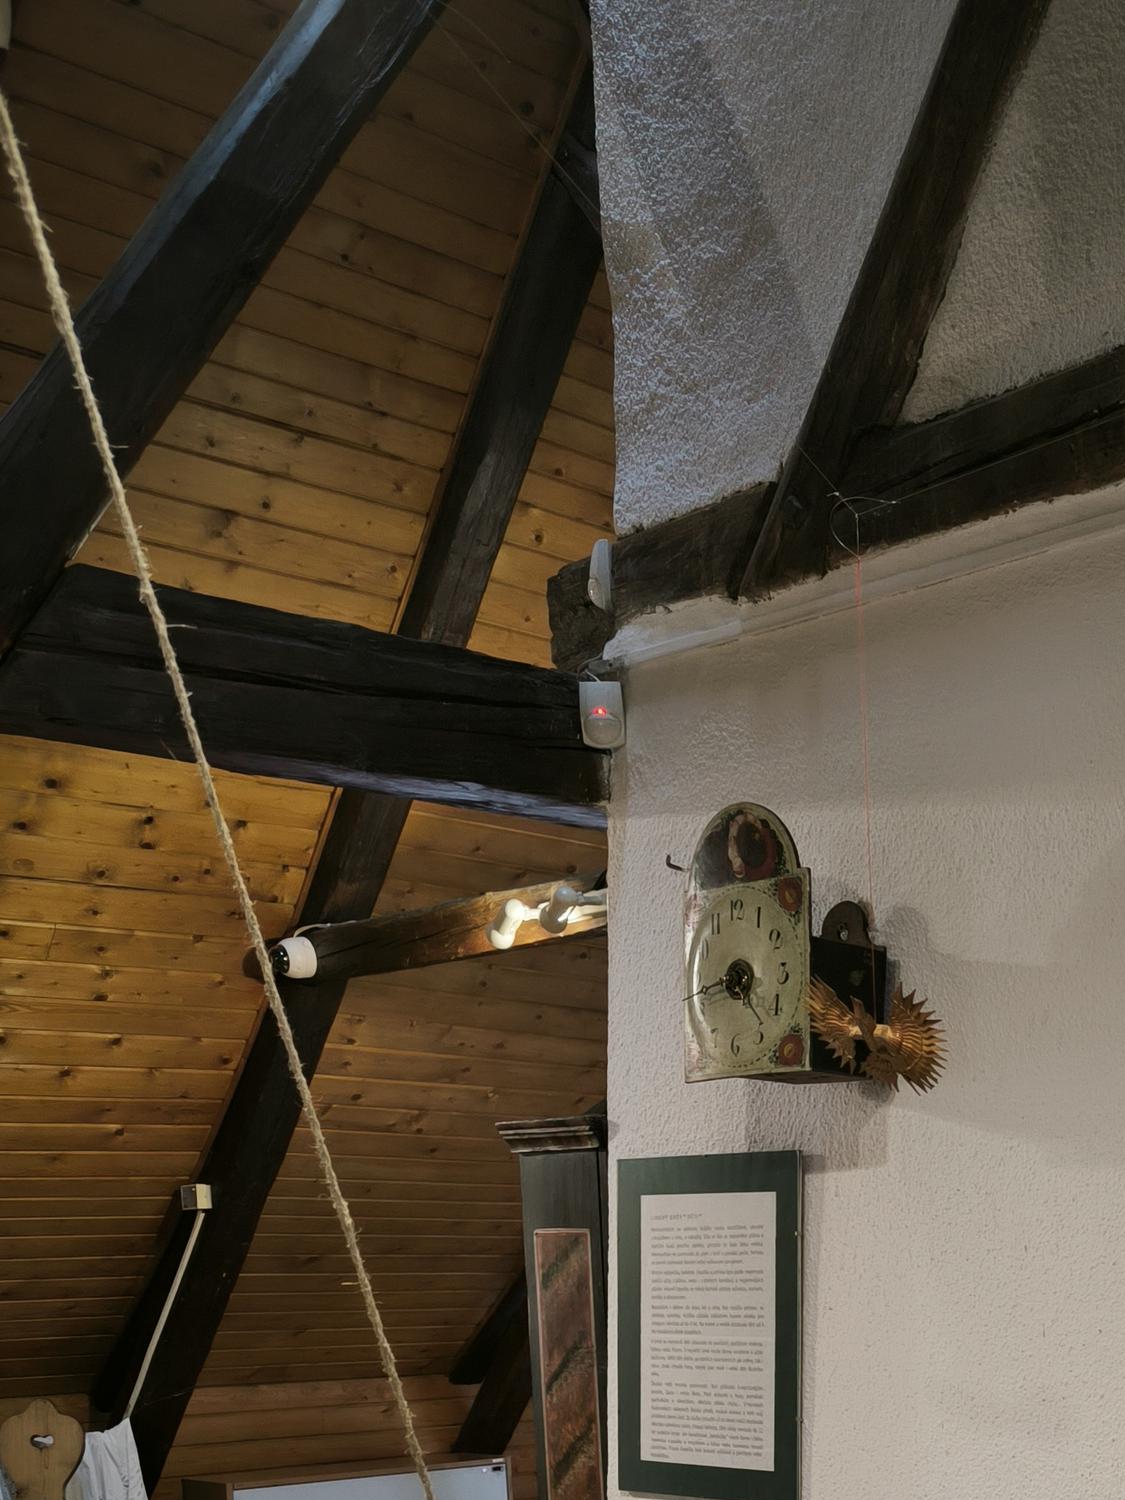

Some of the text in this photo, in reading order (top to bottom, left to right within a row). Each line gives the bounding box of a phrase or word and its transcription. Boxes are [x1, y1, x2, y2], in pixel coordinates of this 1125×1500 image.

[729, 899, 745, 921] 12
[757, 906, 761, 928] 1
[712, 913, 720, 935] 11
[769, 928, 783, 950] 2
[777, 961, 789, 984] 3
[768, 993, 782, 1016] 4
[711, 1028, 719, 1048] 7
[730, 1033, 741, 1056] 6
[753, 1022, 764, 1045] 5
